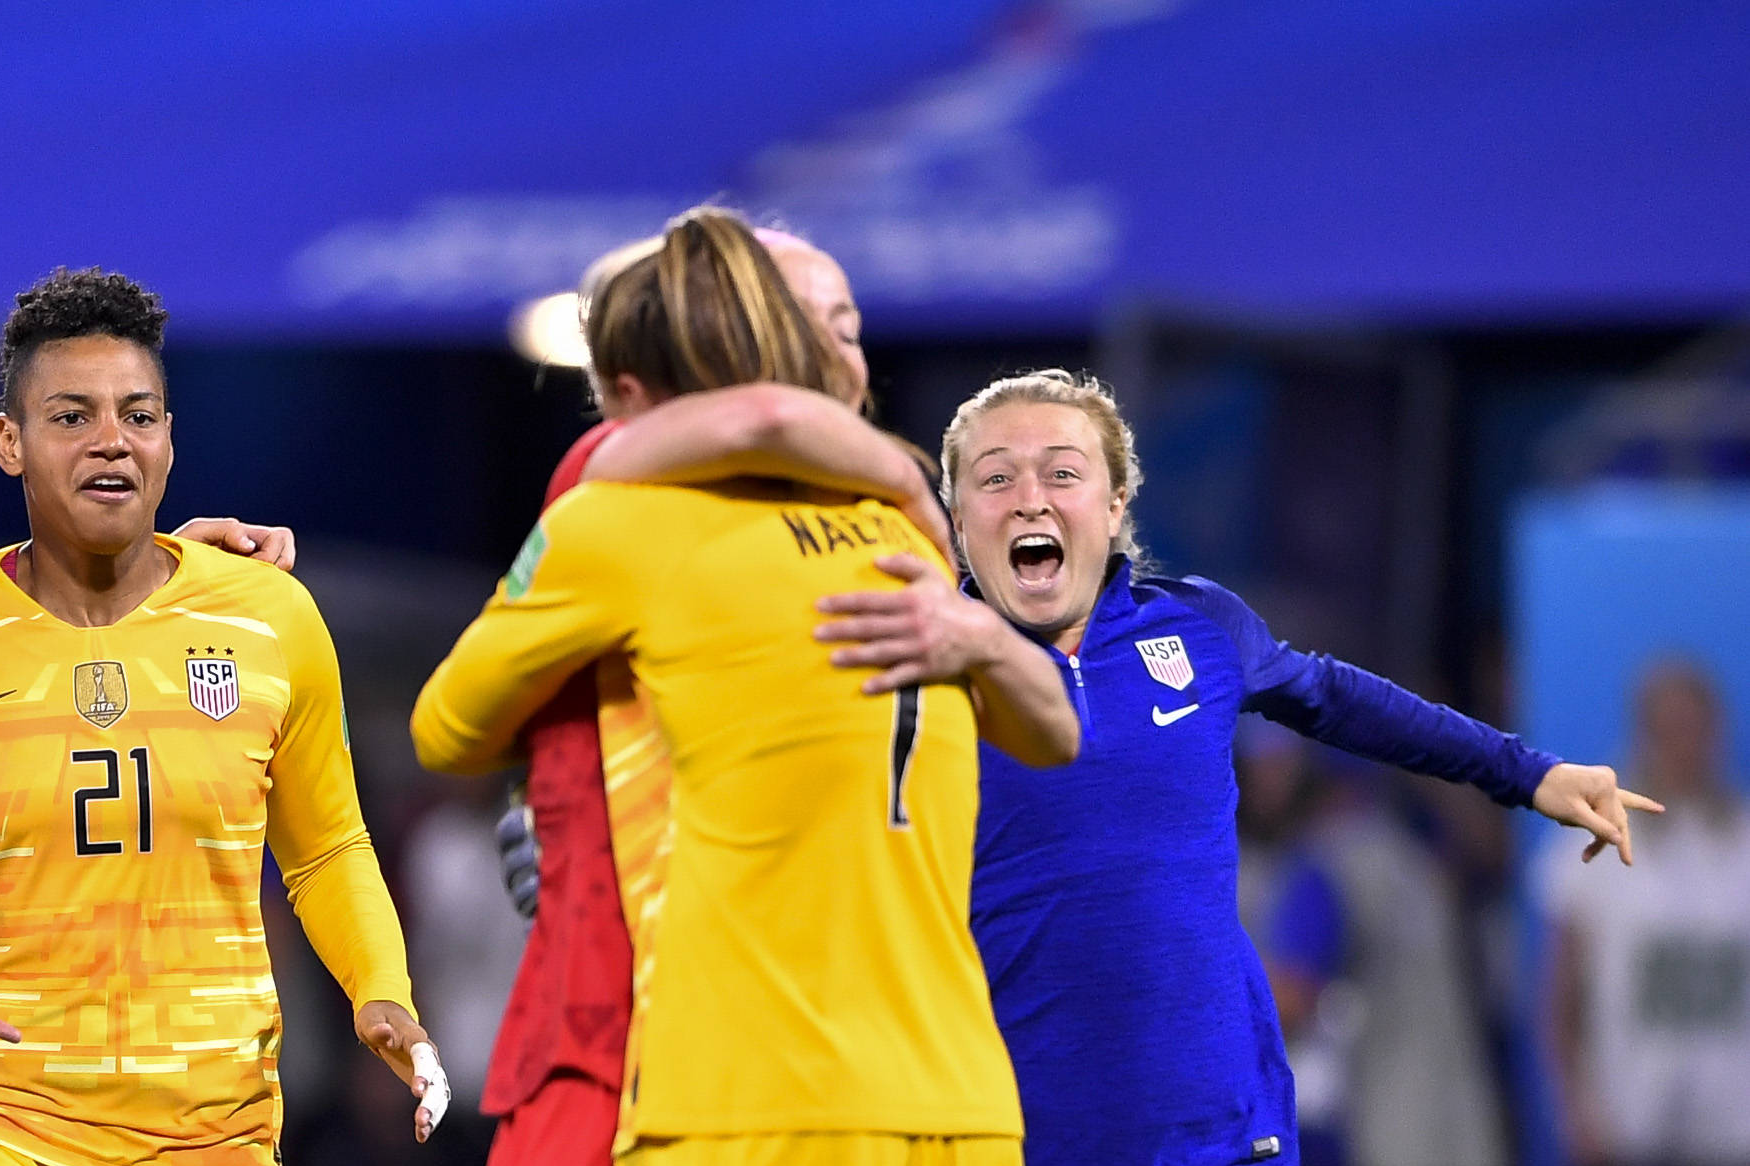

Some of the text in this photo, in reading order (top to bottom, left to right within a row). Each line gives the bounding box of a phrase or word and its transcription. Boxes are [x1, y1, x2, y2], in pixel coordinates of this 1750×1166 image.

[1141, 640, 1180, 660] USA
[192, 663, 233, 685] USA
[89, 701, 116, 713] FIFA
[70, 746, 153, 857] 21
